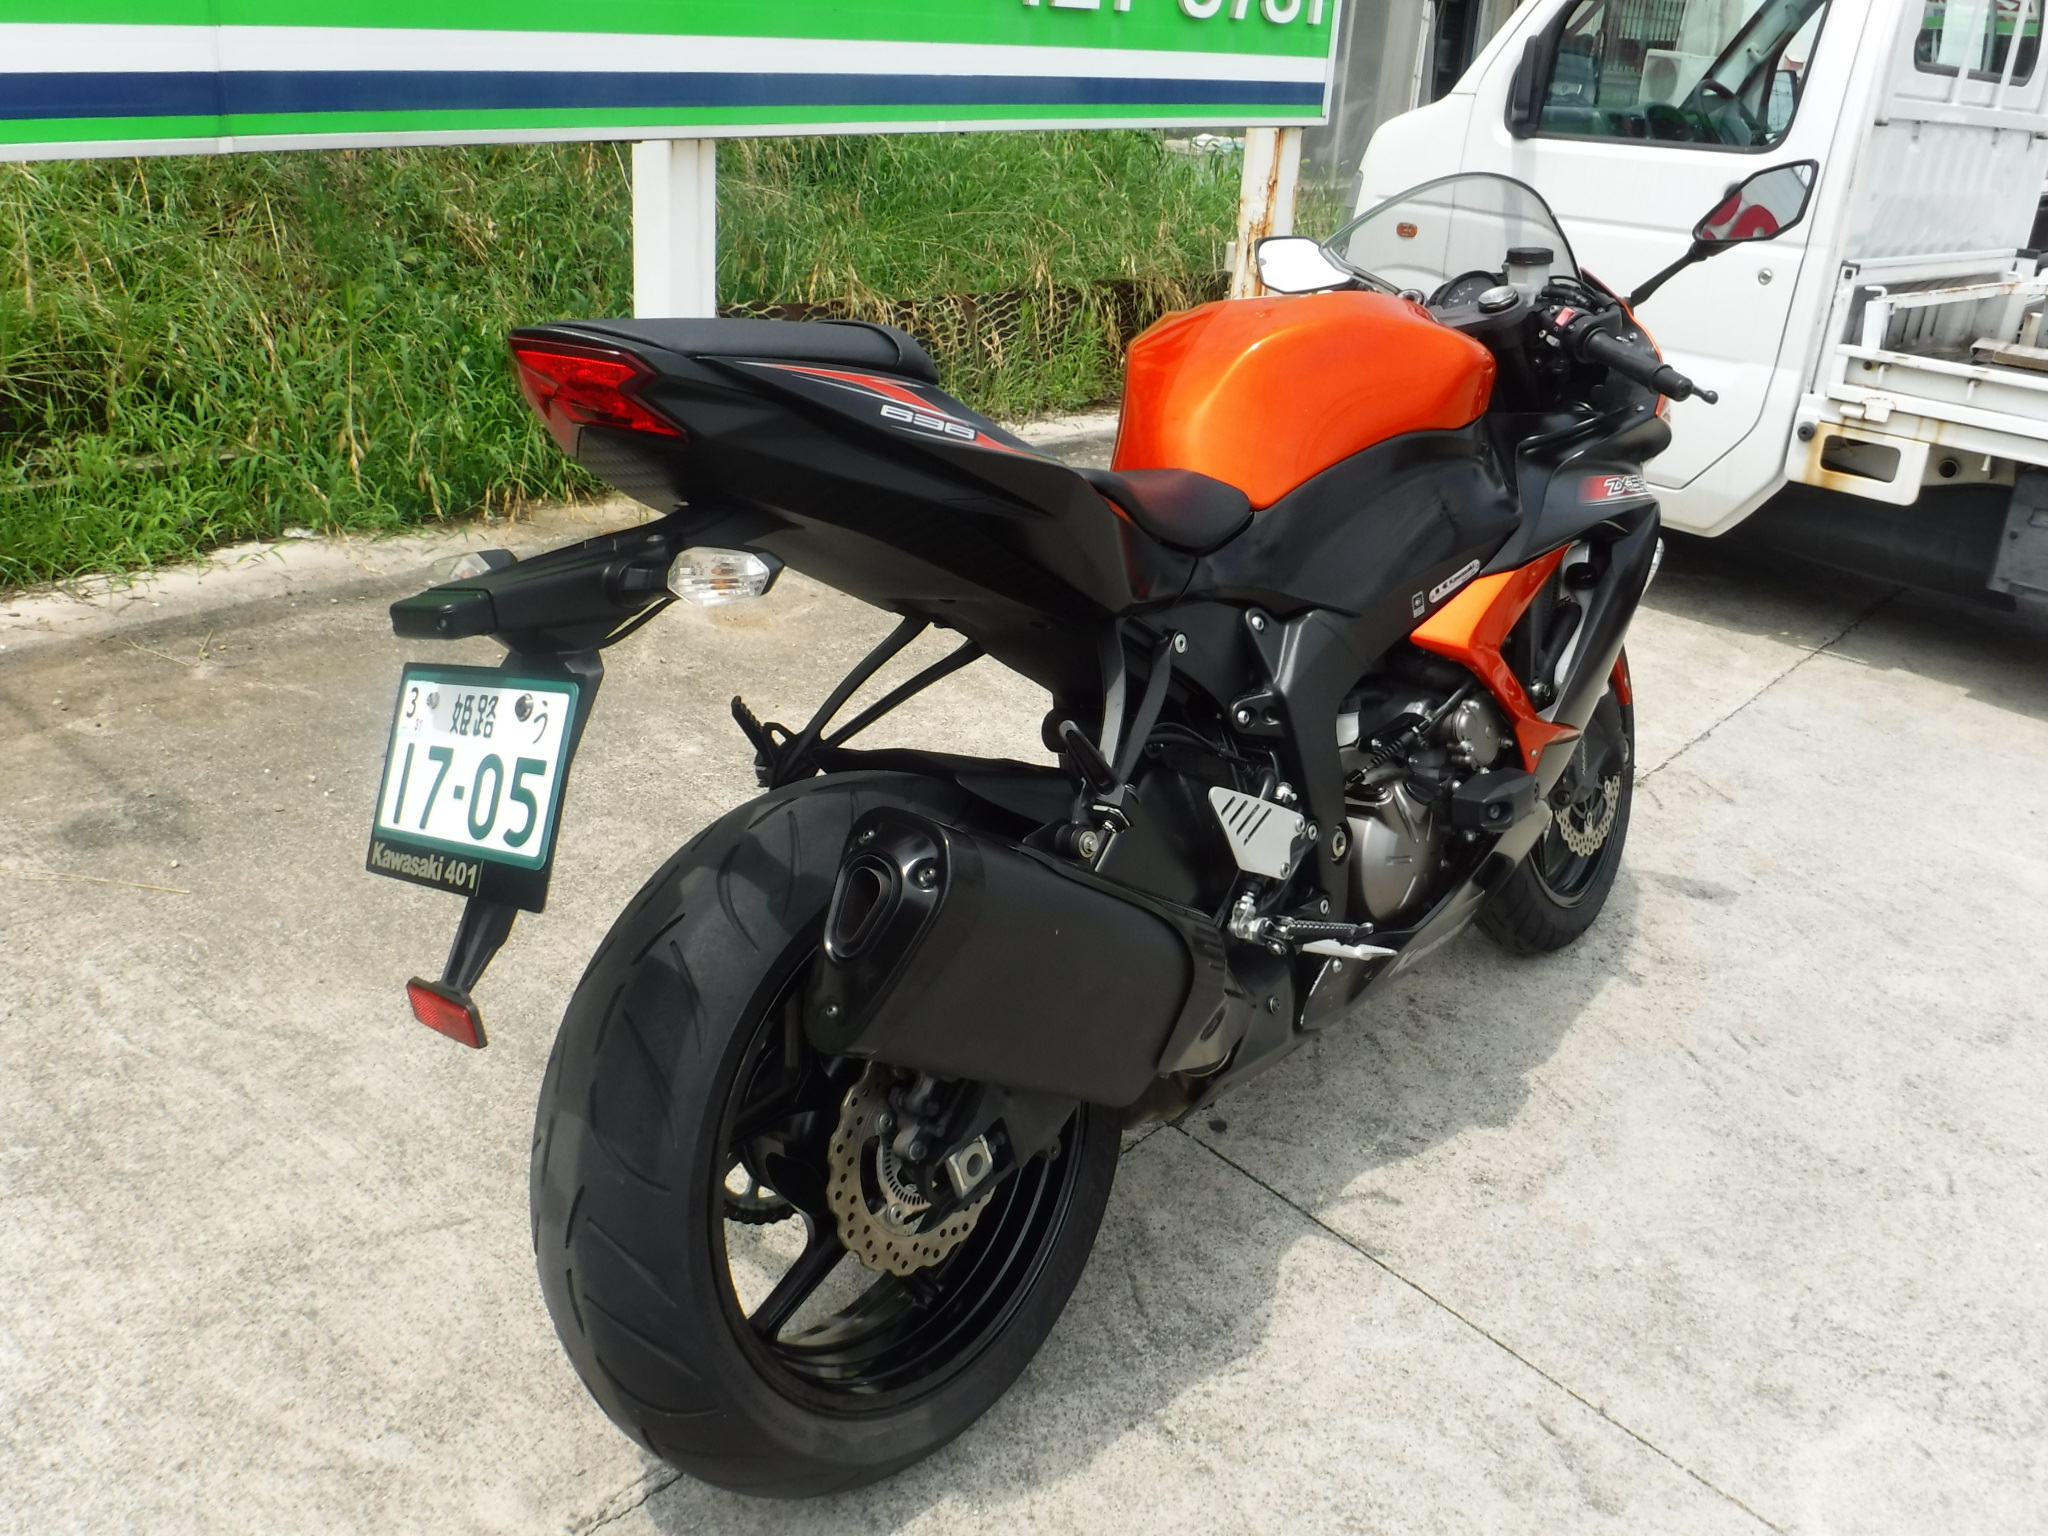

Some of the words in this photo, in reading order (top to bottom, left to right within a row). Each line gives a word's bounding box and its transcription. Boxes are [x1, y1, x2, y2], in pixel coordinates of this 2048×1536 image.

[880, 404, 976, 440] 636
[406, 686, 419, 718] 3
[449, 693, 499, 738] 姫路
[532, 700, 549, 744] う
[392, 742, 548, 848] 17-05
[371, 841, 445, 882] Kawasaki
[444, 859, 478, 890] 401
